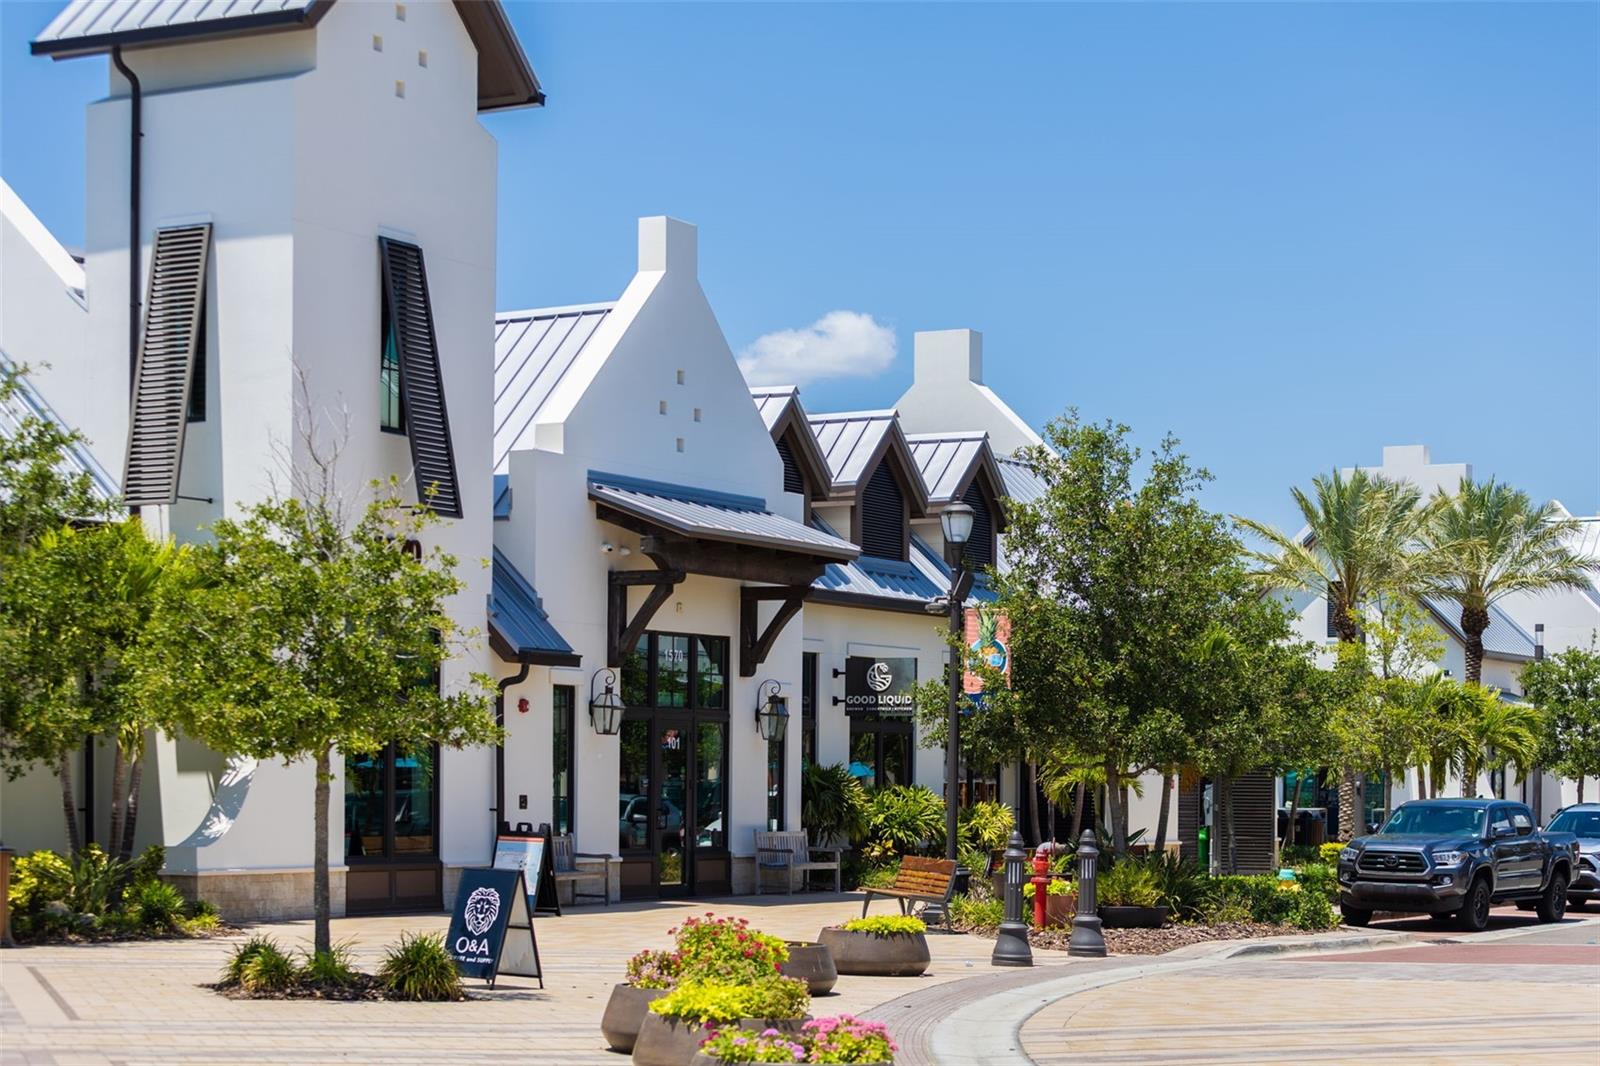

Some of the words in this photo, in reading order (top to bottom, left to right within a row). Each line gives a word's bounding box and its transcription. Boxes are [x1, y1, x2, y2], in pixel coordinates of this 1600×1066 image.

[664, 649, 683, 662] 1570
[846, 695, 876, 704] GOOD
[878, 695, 912, 706] LIQUID
[667, 736, 680, 750] 101
[456, 937, 489, 955] O&A
